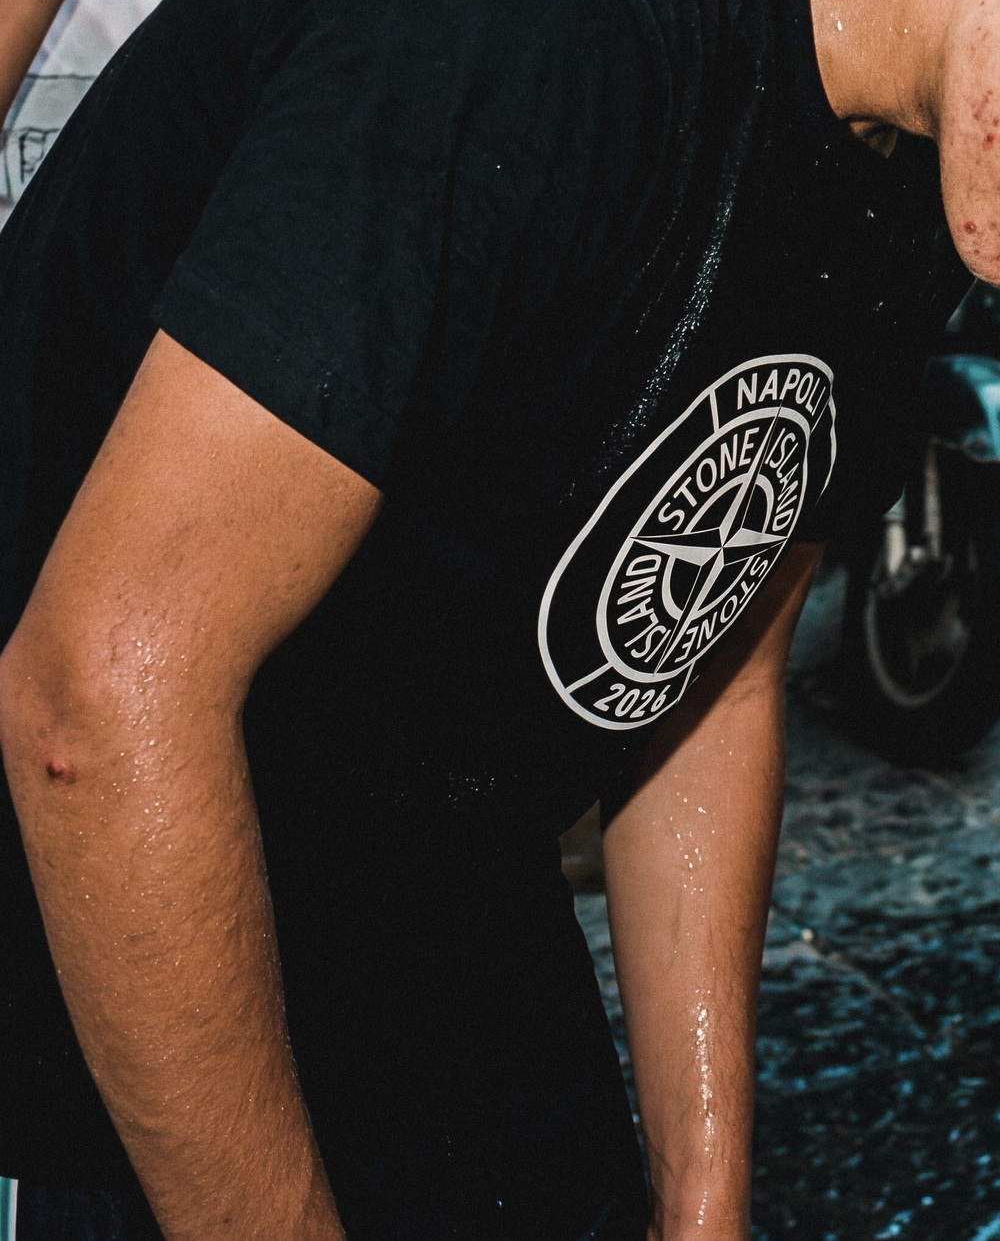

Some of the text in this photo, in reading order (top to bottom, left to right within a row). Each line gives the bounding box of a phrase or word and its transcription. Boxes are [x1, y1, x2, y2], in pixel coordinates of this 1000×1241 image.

[737, 368, 827, 417] NAPOLI
[657, 426, 800, 532] STONE ISLAND
[616, 554, 769, 663] STONE ISLAND
[593, 682, 671, 719] 2026
